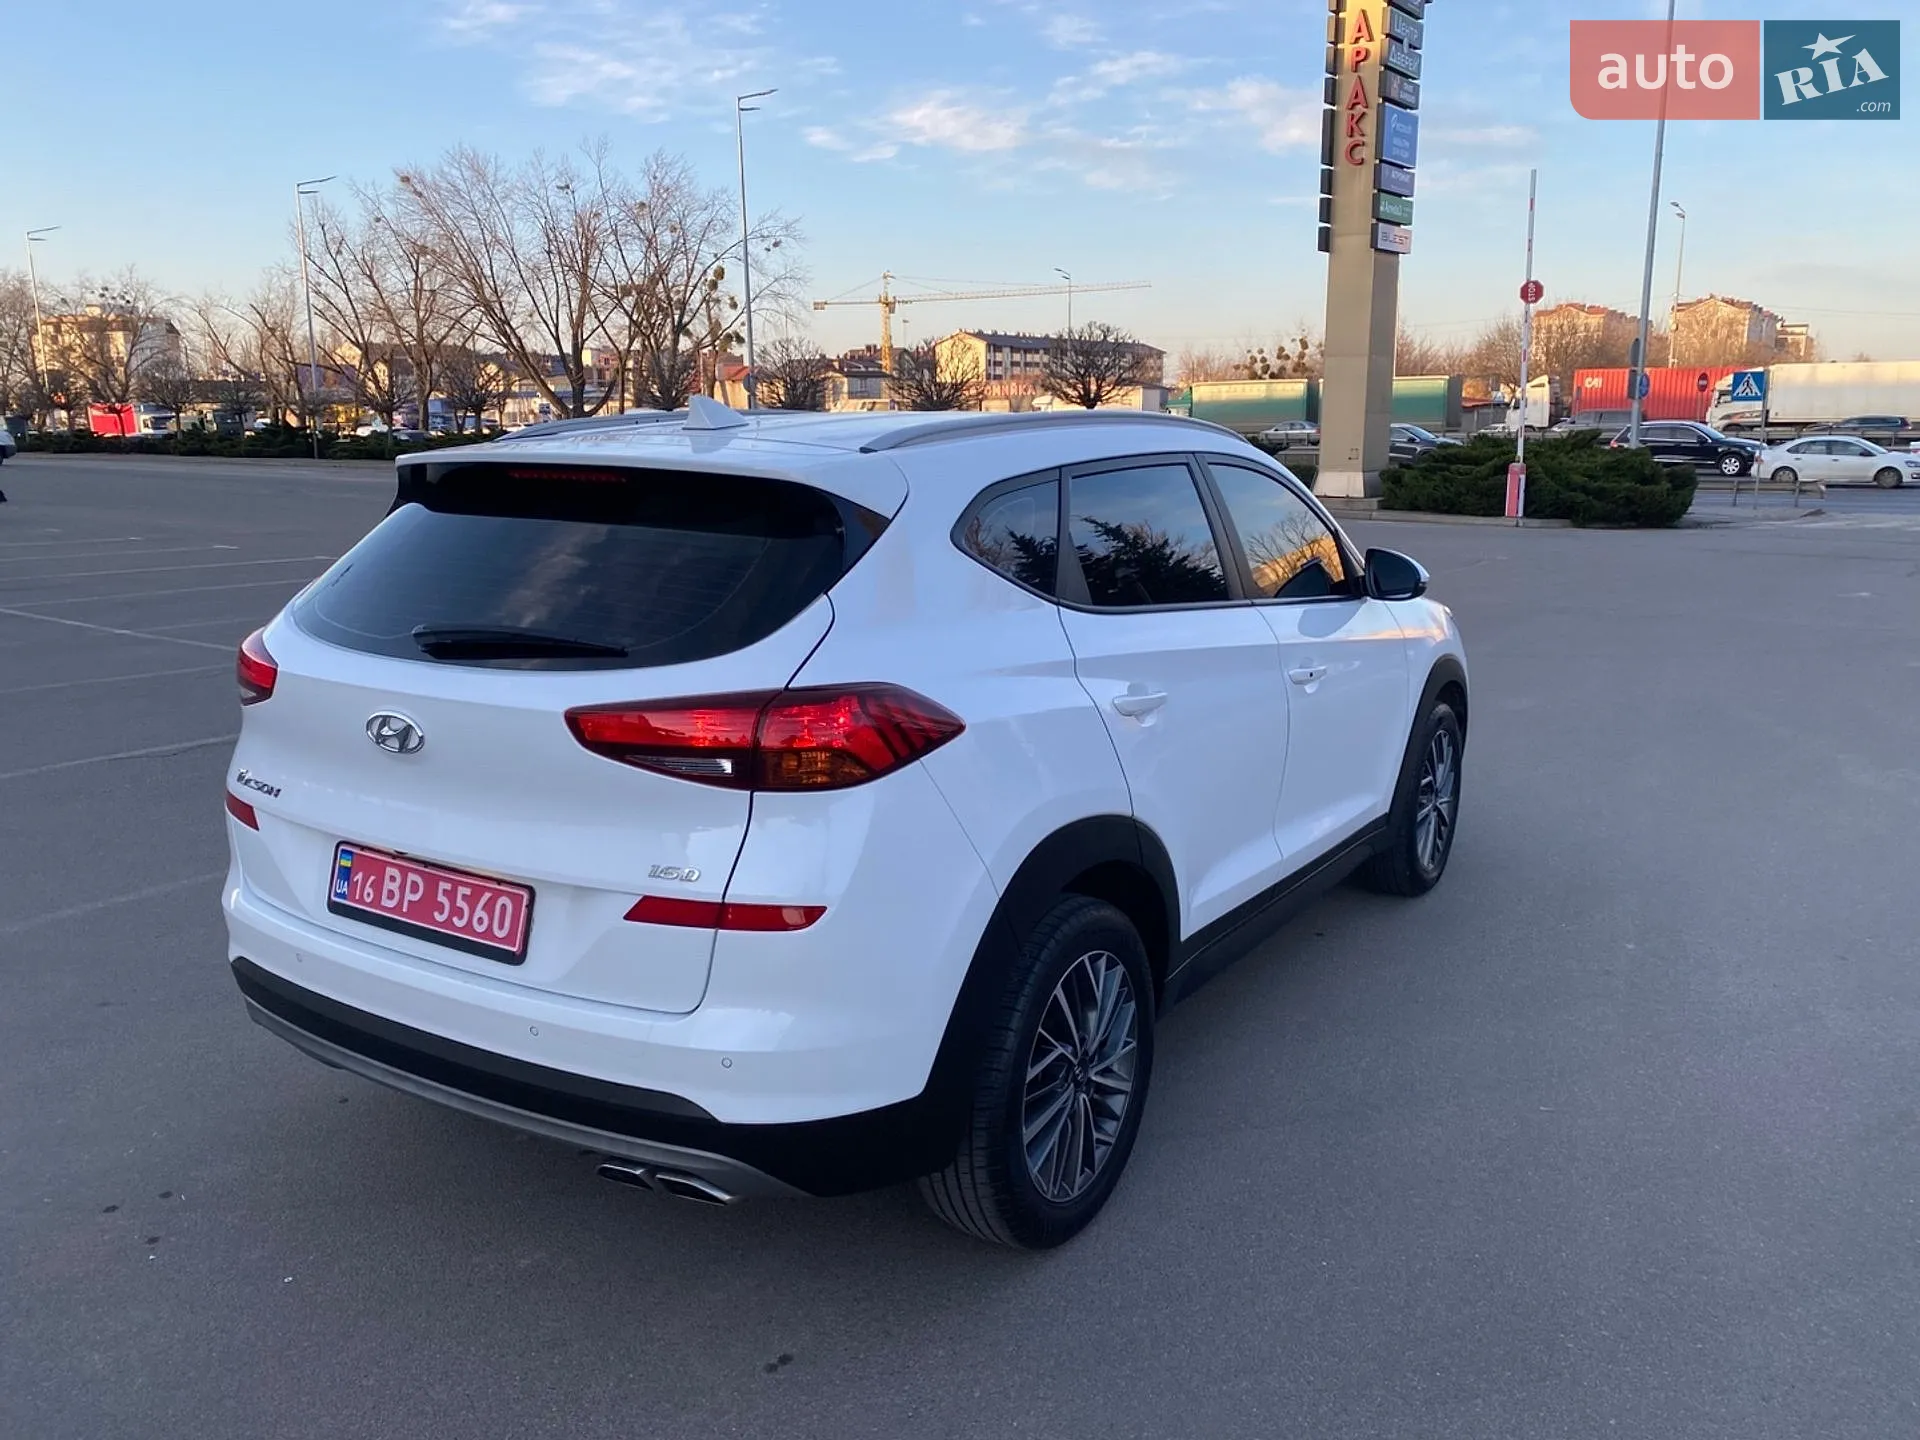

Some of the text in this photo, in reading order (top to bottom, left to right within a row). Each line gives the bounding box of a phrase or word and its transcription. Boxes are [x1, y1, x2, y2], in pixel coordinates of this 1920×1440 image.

[1344, 8, 1375, 166] АРАКС
[335, 878, 349, 896] UA
[353, 871, 377, 903] 16
[432, 881, 513, 939] 5560
